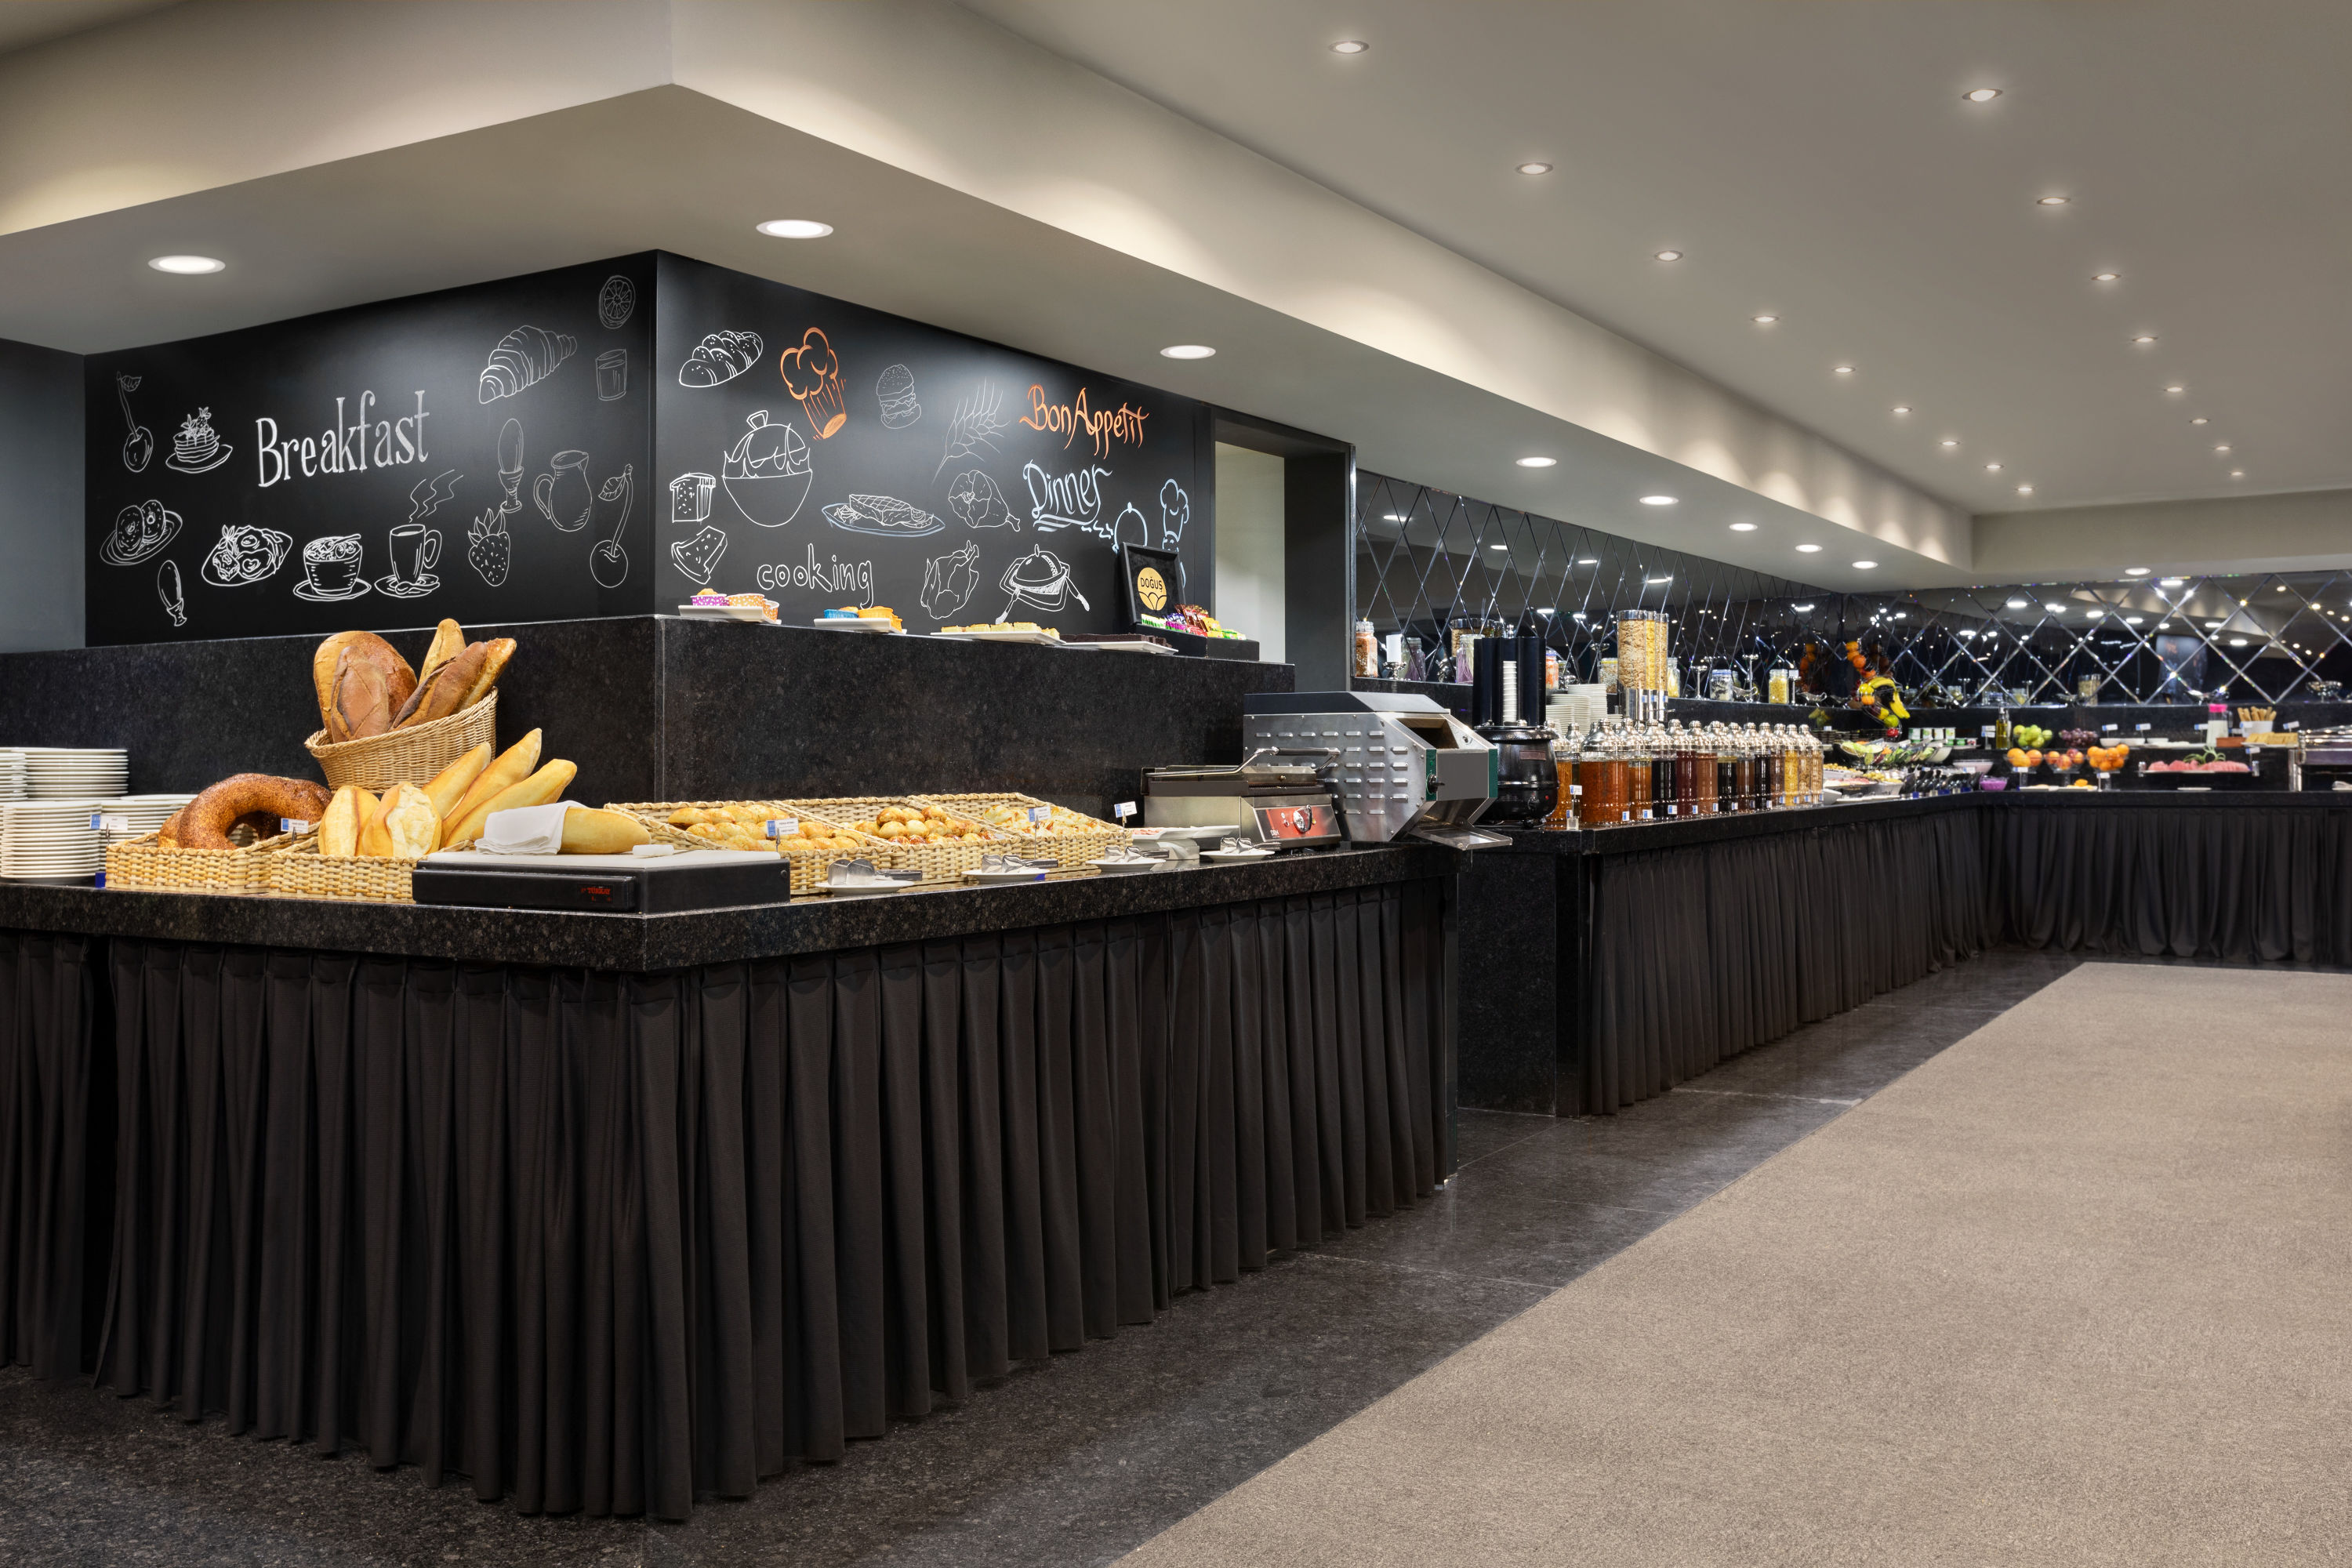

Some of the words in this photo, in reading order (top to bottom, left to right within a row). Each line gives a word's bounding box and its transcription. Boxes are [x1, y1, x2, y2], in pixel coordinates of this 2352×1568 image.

[256, 390, 430, 488] Breakfast
[1023, 459, 1112, 524] Dinner
[757, 543, 874, 610] cooking
[1140, 576, 1163, 592] DOĞUŞ
